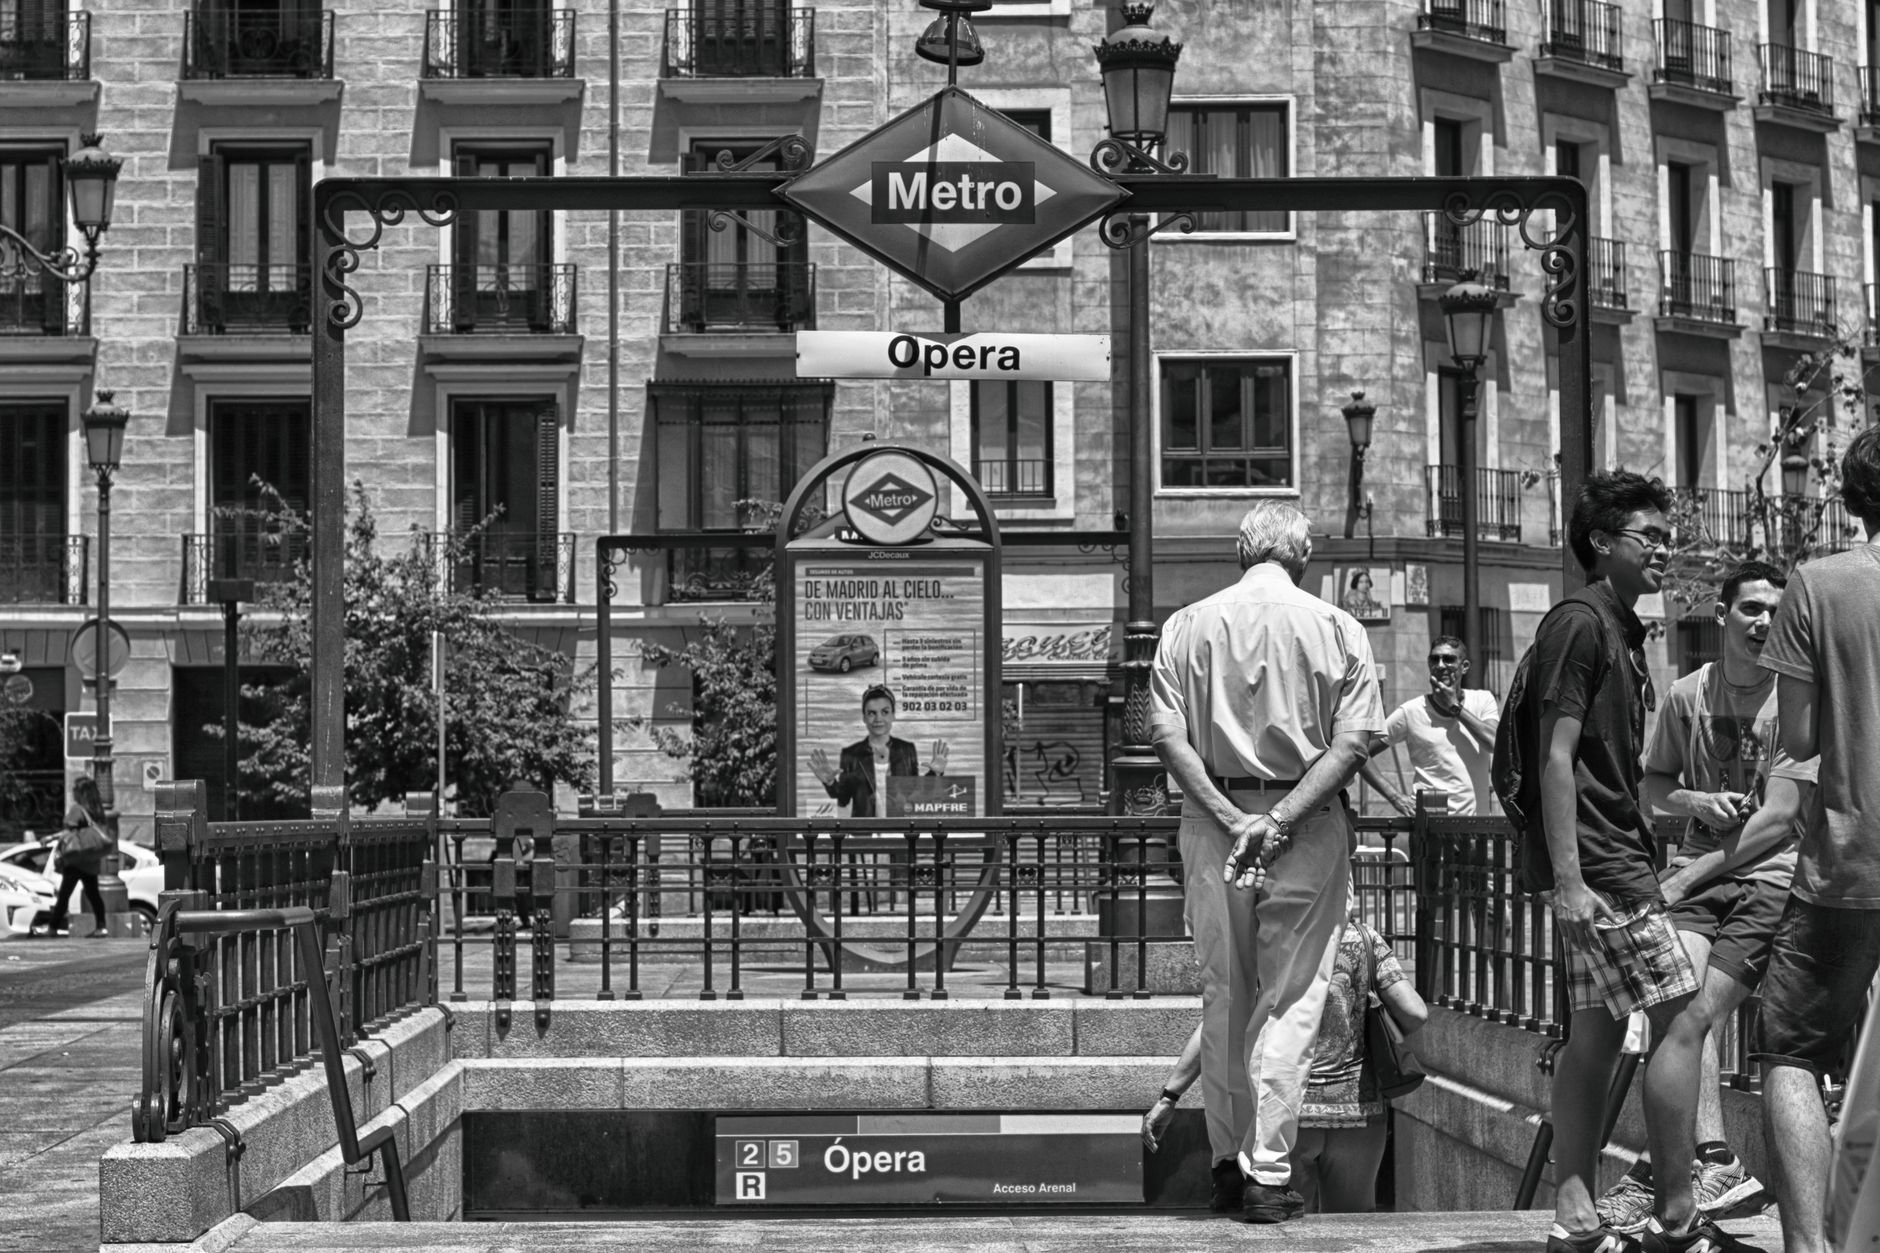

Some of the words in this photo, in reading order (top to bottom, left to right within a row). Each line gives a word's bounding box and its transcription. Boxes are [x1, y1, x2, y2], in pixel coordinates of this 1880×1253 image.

[887, 172, 1022, 211] Metro
[887, 335, 1021, 377] Opera
[870, 494, 912, 508] Metro
[868, 551, 910, 559] JCDecaux
[805, 580, 821, 599] DE
[826, 580, 878, 599] MADRID
[882, 580, 900, 599] AL
[903, 580, 954, 599] CIELO...
[805, 601, 831, 620] CON
[902, 702, 922, 711] 902
[924, 702, 937, 711] 03
[939, 702, 952, 711] 02
[954, 702, 967, 711] 03
[914, 803, 967, 812] MAPFRE
[742, 1144, 758, 1165] 2
[776, 1144, 791, 1165] 5
[824, 1138, 926, 1179] Ópera
[742, 1174, 761, 1197] R
[993, 1183, 1036, 1194] Acceso
[1039, 1182, 1076, 1193] Arenal
